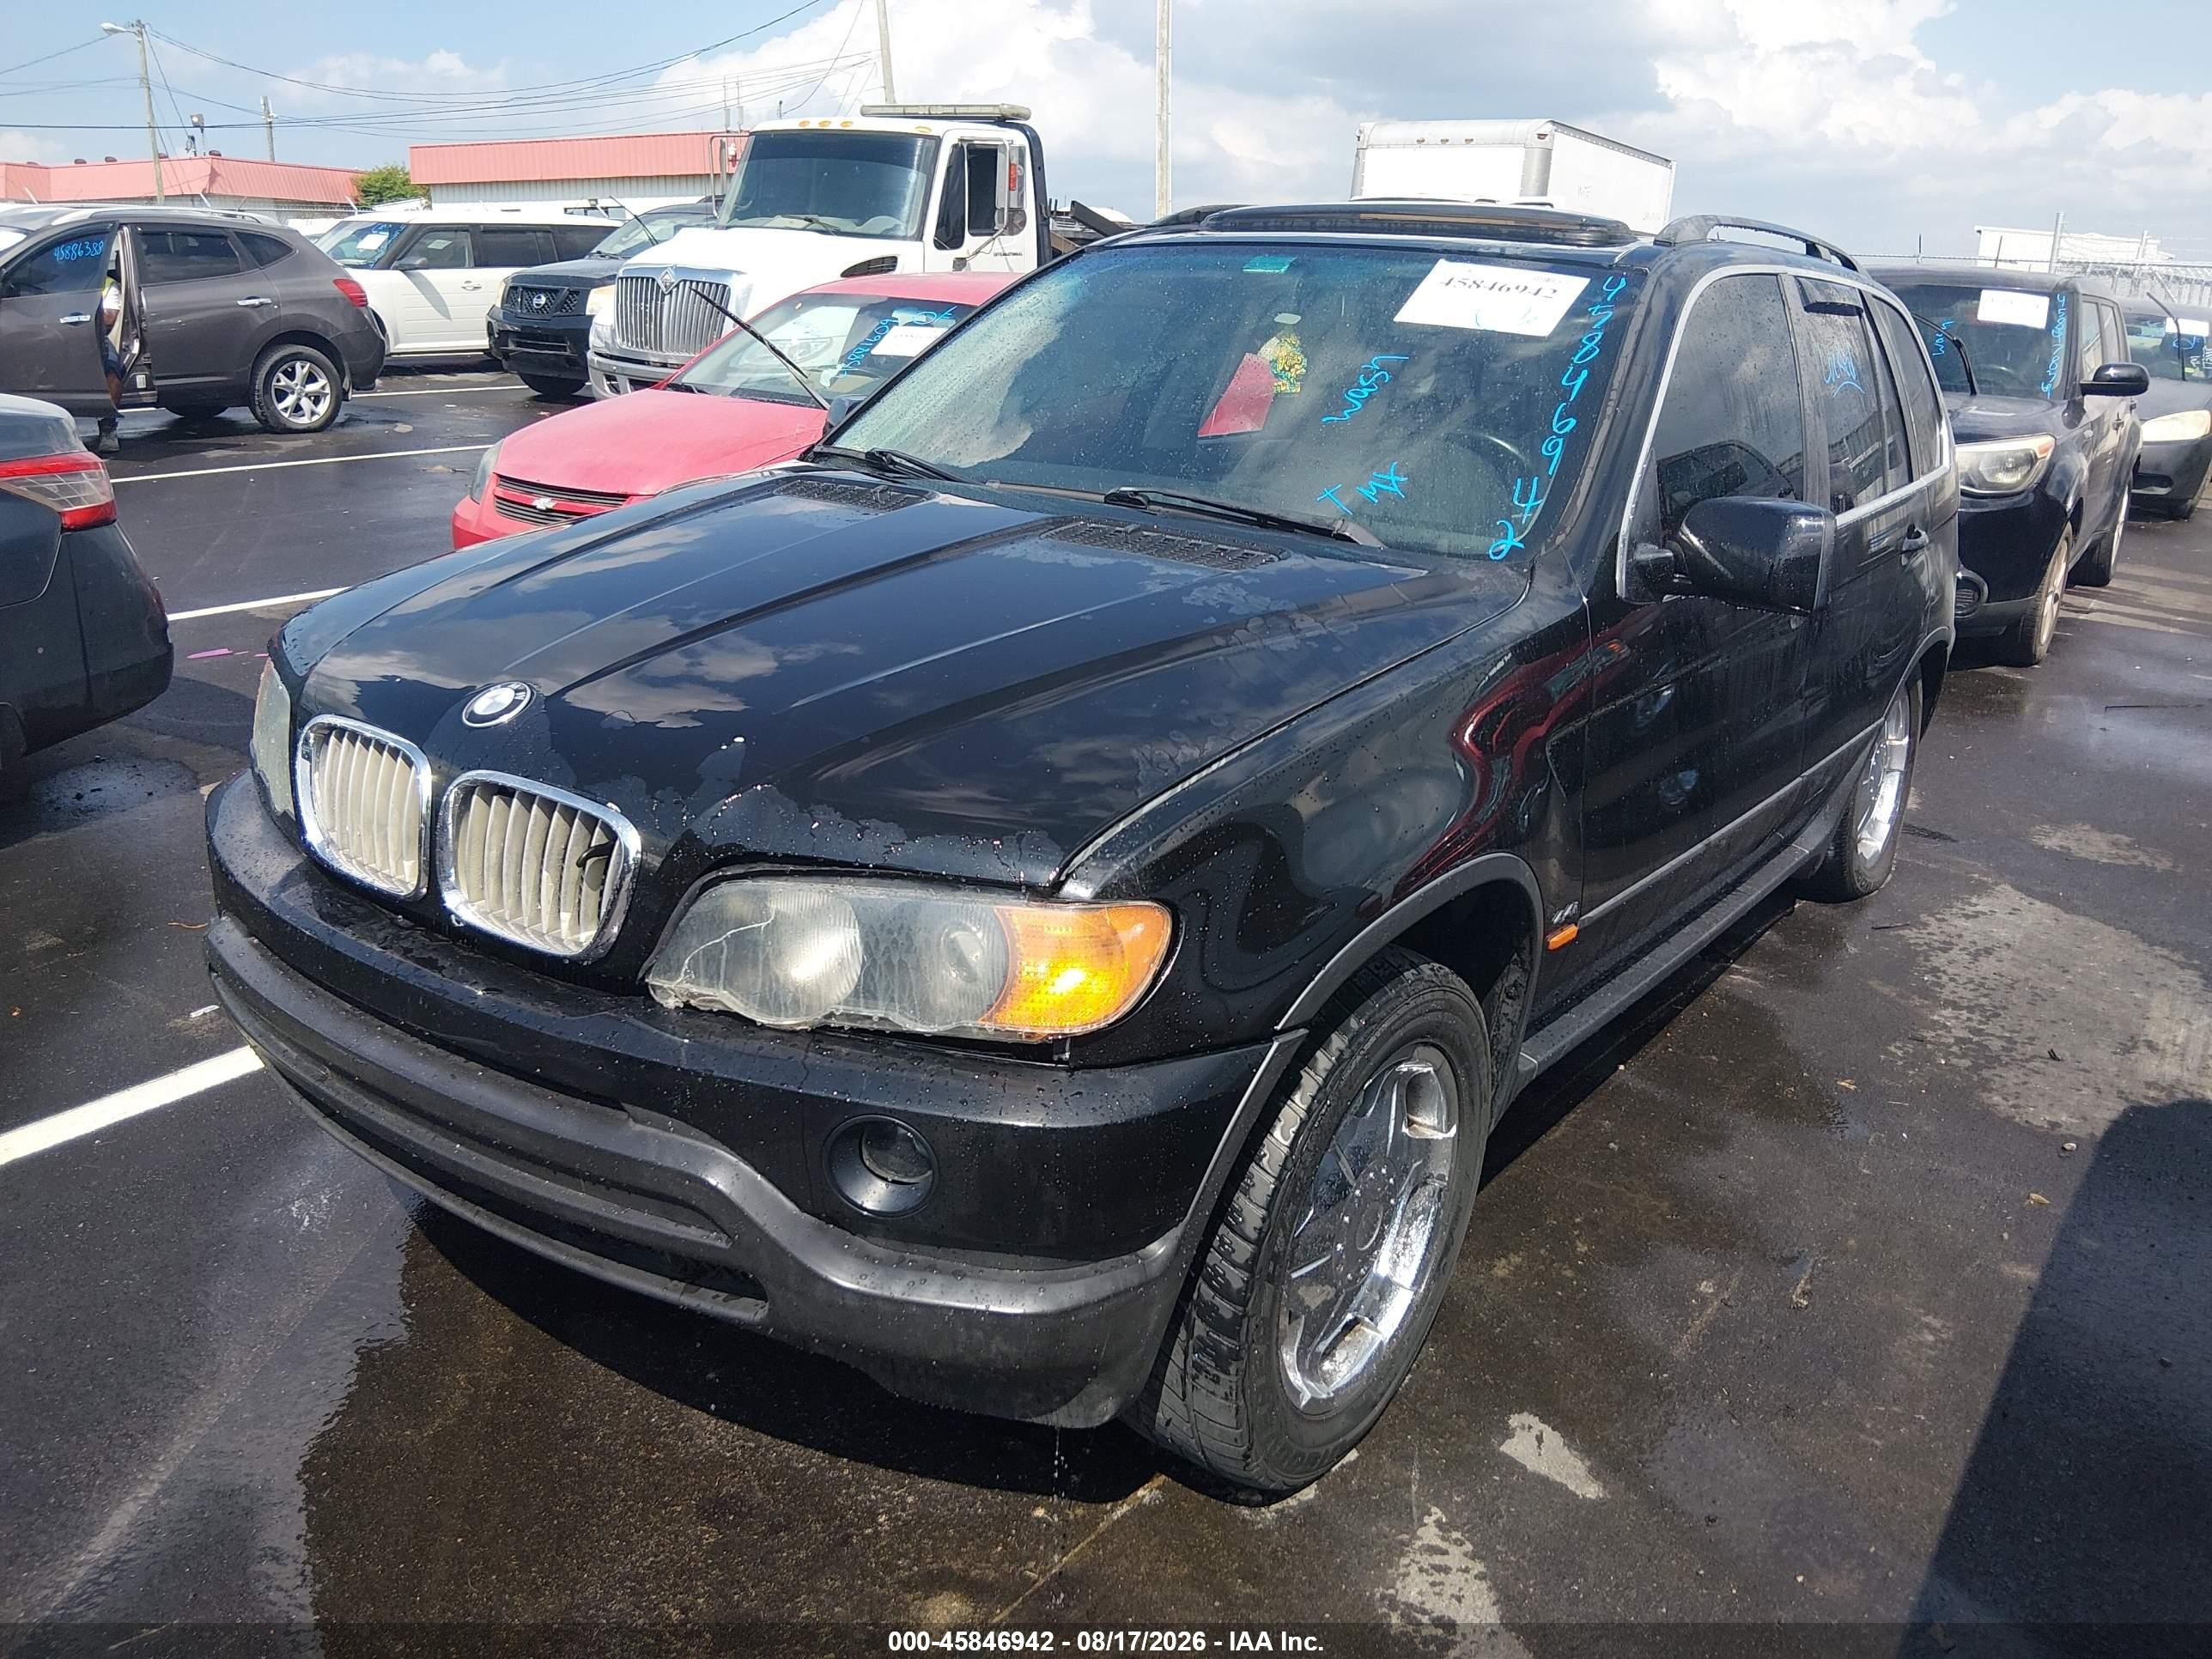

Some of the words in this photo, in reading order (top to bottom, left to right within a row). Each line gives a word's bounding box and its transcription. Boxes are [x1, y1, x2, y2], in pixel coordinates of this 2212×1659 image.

[55, 240, 104, 261] 45886388
[1440, 276, 1558, 299] 45846942
[1488, 274, 1626, 560] 45846942
